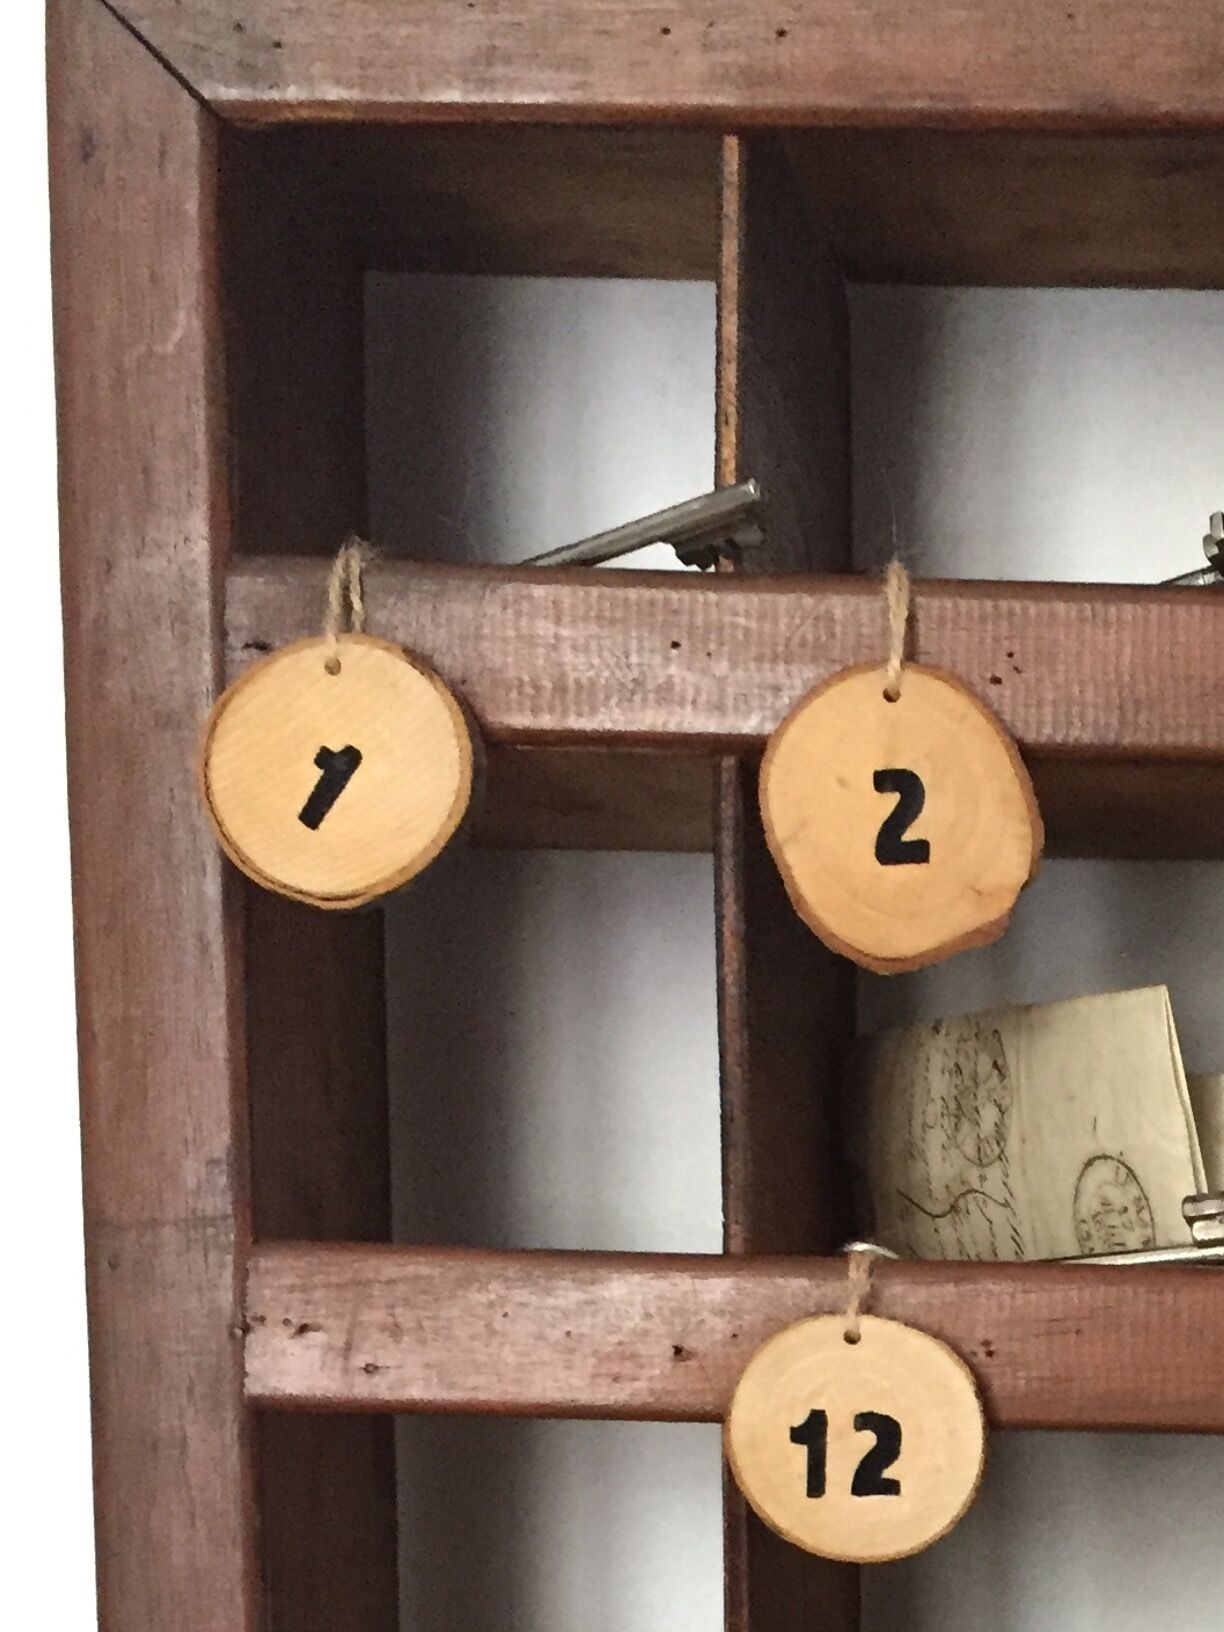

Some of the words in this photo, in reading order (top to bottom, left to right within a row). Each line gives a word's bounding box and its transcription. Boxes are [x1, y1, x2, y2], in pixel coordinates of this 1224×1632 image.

[297, 744, 363, 831] 1
[872, 767, 931, 866] 2
[788, 1408, 902, 1499] 12
